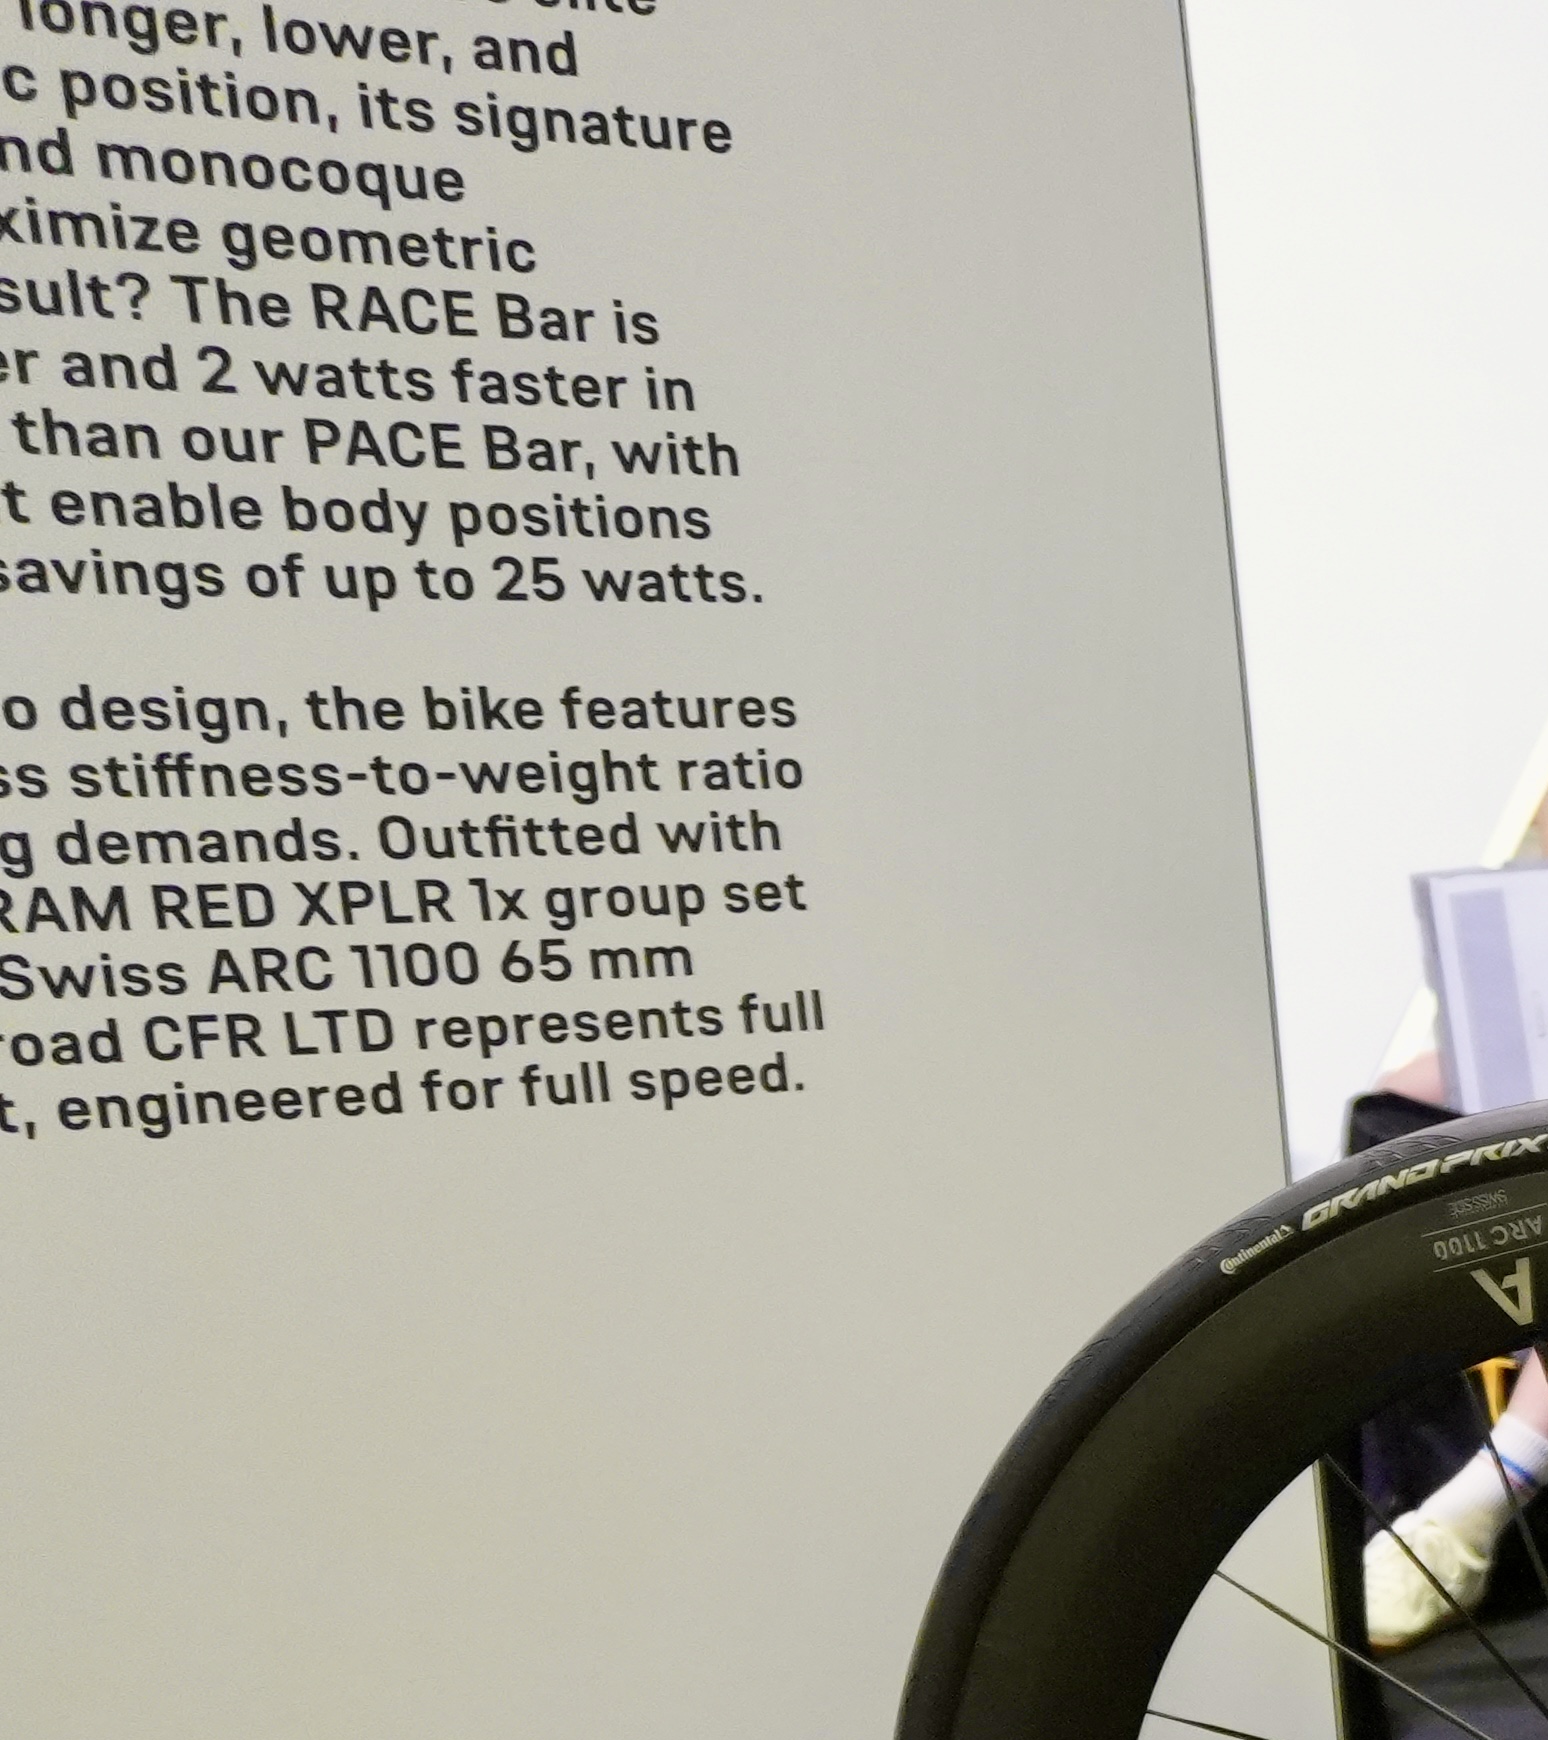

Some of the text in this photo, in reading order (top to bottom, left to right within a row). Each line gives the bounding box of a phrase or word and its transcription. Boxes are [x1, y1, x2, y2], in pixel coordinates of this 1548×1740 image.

[19, 0, 578, 77] longer, lower, and
[60, 67, 732, 154] position, its signature
[96, 143, 465, 211] monocoque
[221, 222, 536, 273] geometric
[169, 275, 291, 328] The
[310, 283, 478, 337] RACE
[496, 293, 595, 342] Bar
[613, 299, 659, 345] is
[246, 552, 305, 598] of
[324, 565, 397, 612] up
[413, 559, 474, 600] to
[492, 556, 565, 602] 25
[581, 563, 762, 603] watts.
[60, 684, 796, 744] design, the bike features
[69, 748, 802, 805] stiffness-to-weight ratio
[56, 809, 781, 865] demands. Outfitted with
[151, 883, 275, 930] RED
[292, 879, 455, 926] XPLR
[468, 878, 529, 921] 1x
[545, 884, 705, 931] group
[724, 874, 807, 913] set
[0, 938, 693, 1000] Swiss ARC 1100 65 mm
[144, 1013, 267, 1061] CFR
[283, 1008, 394, 1055] LTD
[416, 1000, 723, 1059] represents
[738, 989, 824, 1034] full
[58, 1051, 804, 1139] engineered for full speed.
[1302, 1159, 1440, 1232] GRAND
[1439, 1133, 1548, 1174] PRIX
[1219, 1229, 1284, 1275] Continental
[1433, 1214, 1544, 1261] ARC 1100
[1470, 1256, 1533, 1326] A
